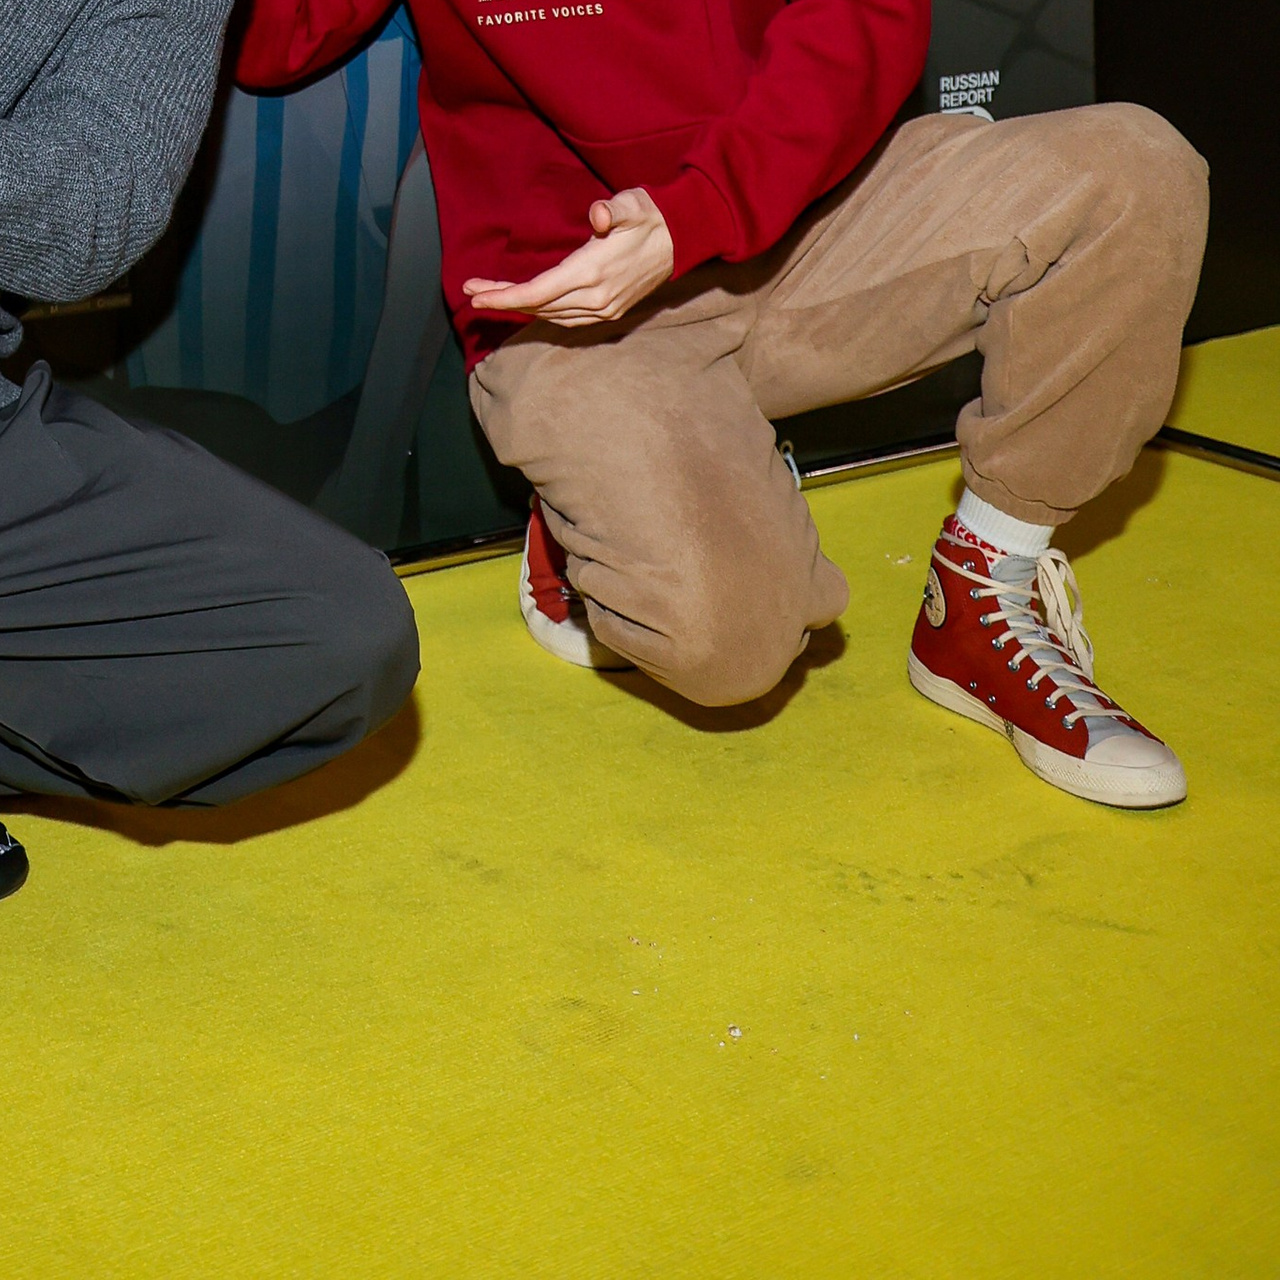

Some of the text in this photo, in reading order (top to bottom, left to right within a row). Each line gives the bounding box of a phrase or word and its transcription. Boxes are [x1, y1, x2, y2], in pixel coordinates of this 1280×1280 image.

[477, 3, 604, 26] FAVORITE VOICES
[940, 70, 1000, 92] RUSSIAN
[940, 87, 995, 108] REPORT
